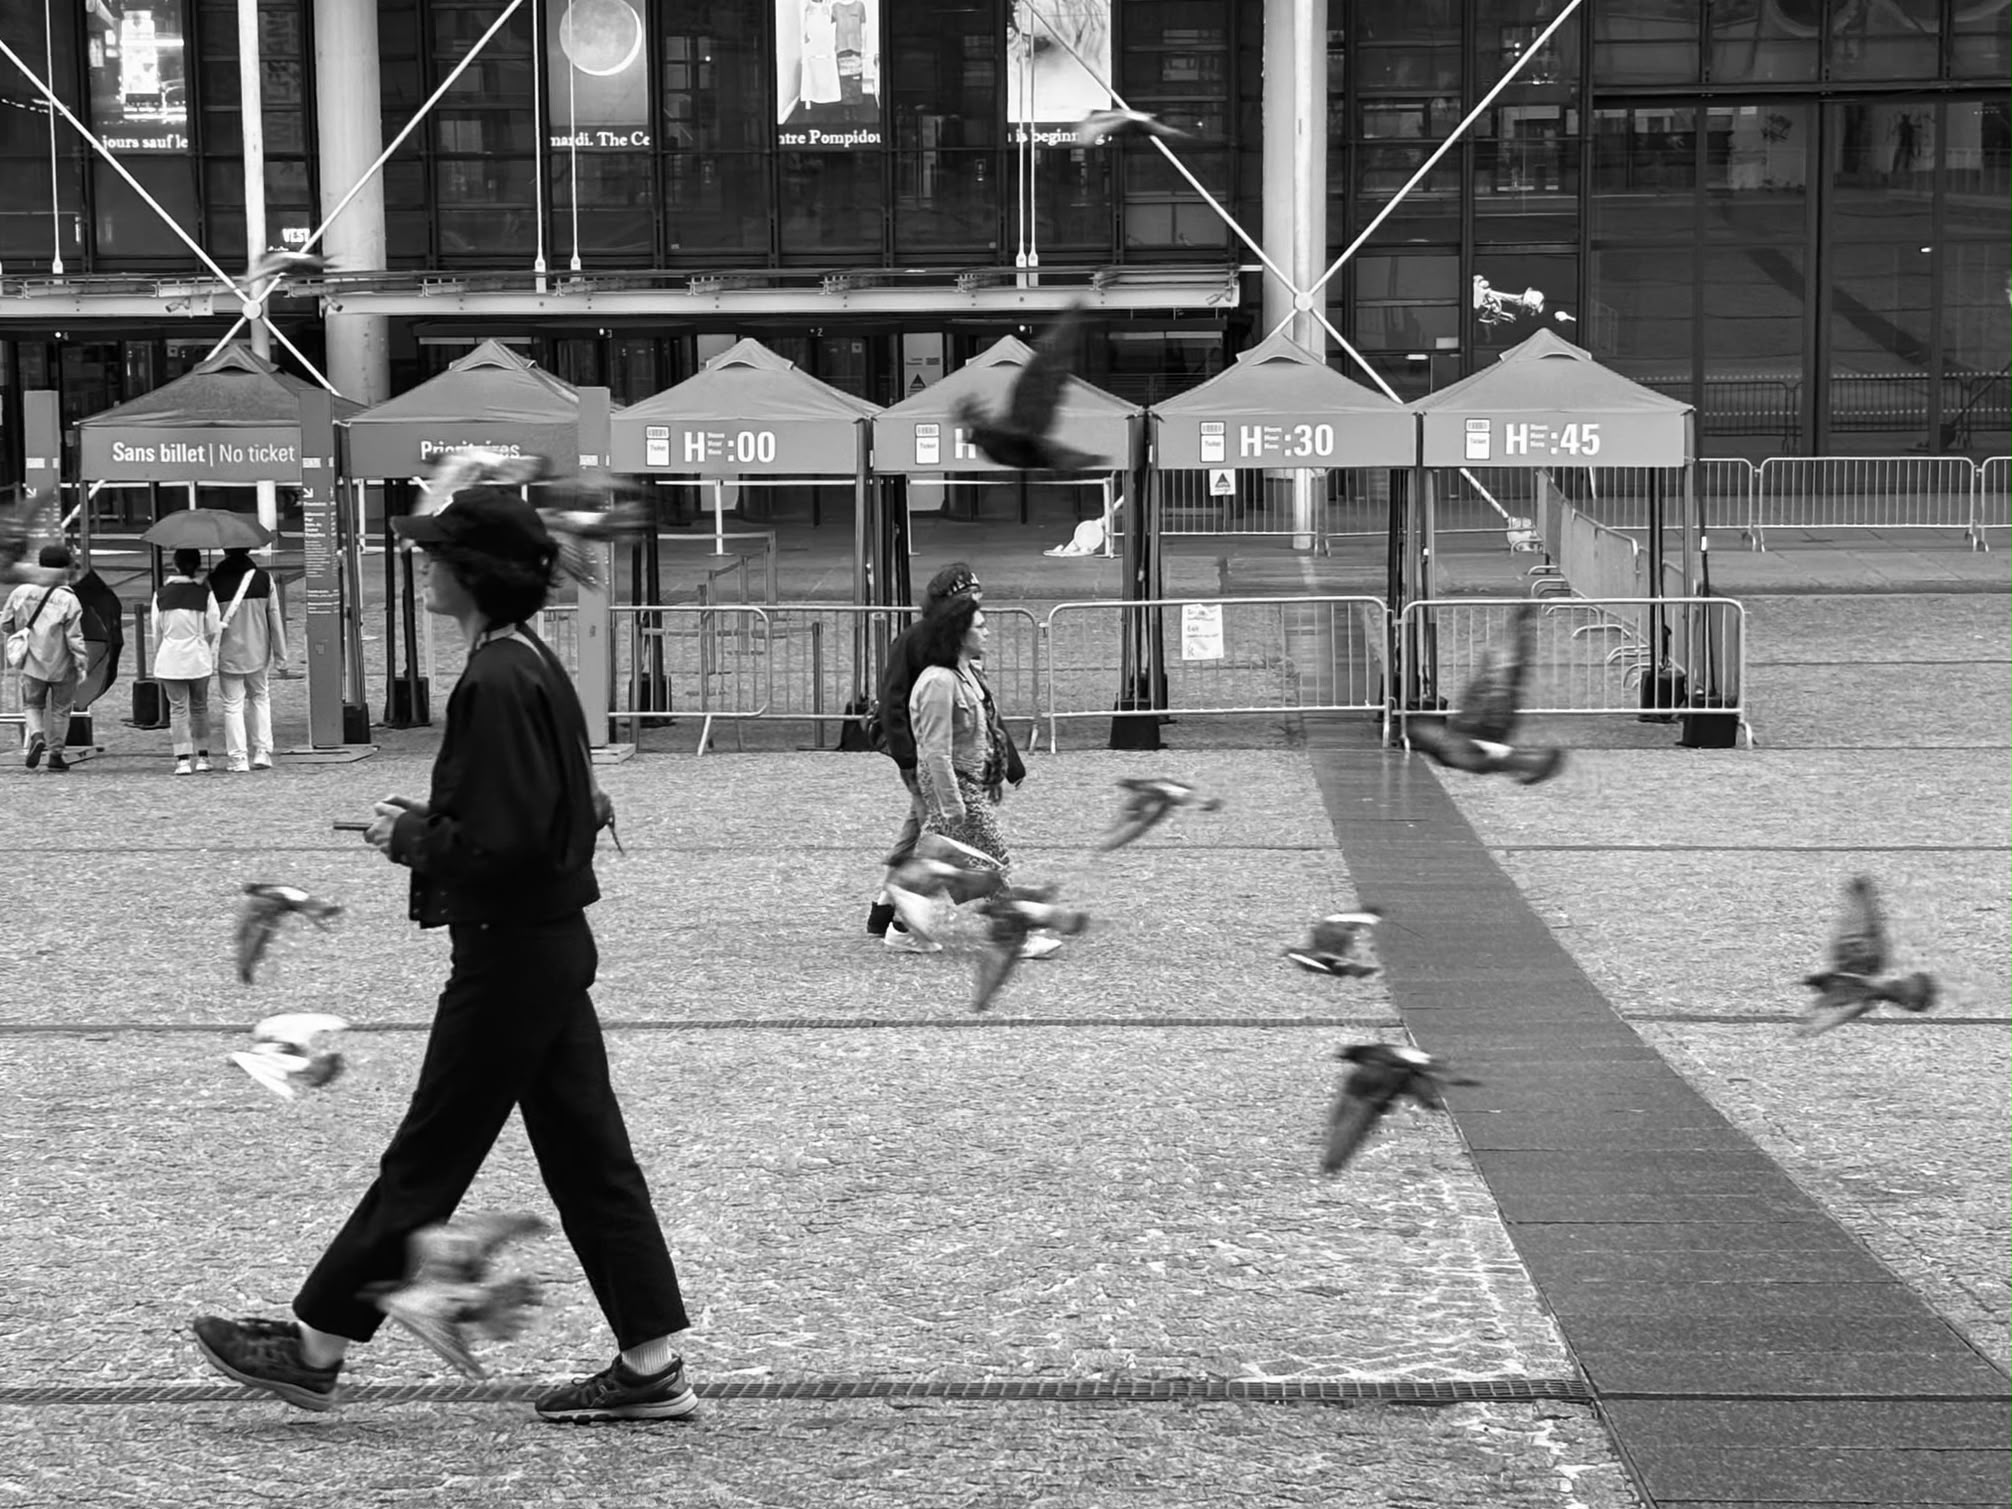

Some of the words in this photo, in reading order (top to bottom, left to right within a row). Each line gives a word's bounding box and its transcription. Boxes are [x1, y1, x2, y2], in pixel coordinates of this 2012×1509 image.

[102, 134, 140, 150] jours
[142, 134, 174, 149] sauf
[175, 134, 189, 149] le
[596, 131, 628, 147] The
[817, 327, 824, 337] 2
[112, 441, 156, 462] Sans
[160, 442, 206, 463] billet
[219, 443, 243, 463] No
[247, 443, 296, 463] ticket
